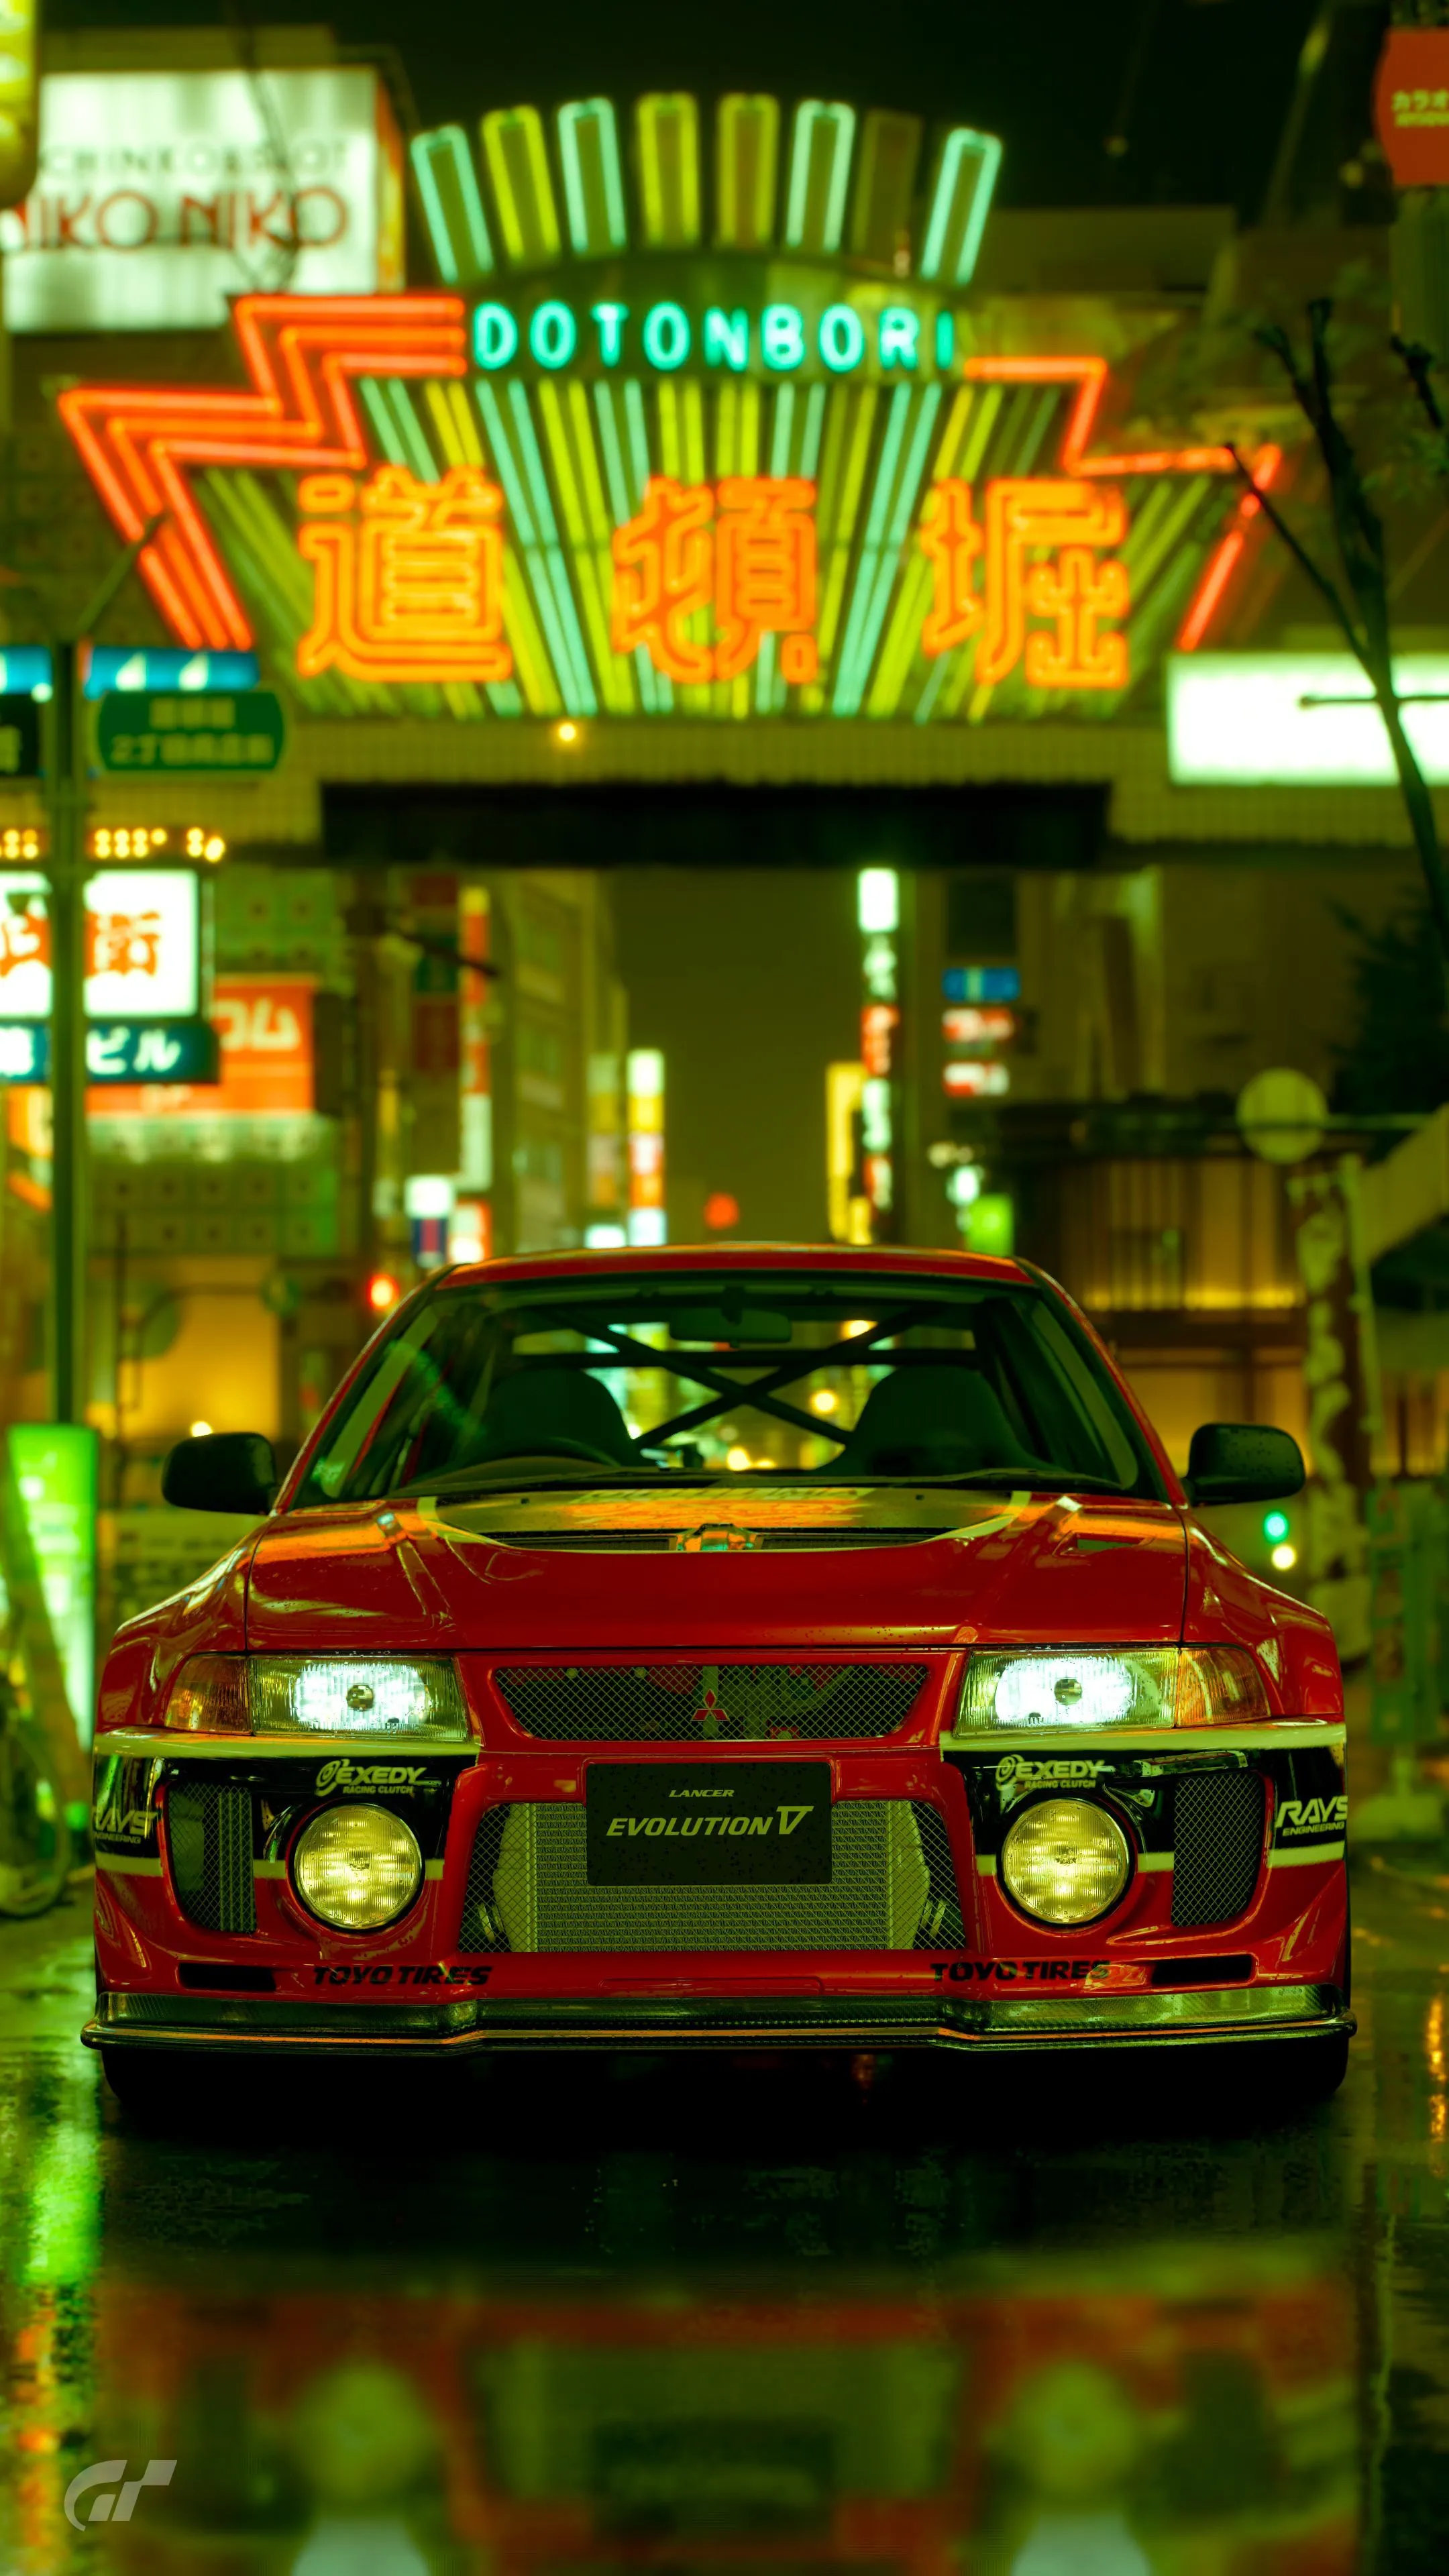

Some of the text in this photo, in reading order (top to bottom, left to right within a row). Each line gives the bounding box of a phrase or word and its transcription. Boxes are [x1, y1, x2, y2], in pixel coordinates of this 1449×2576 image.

[472, 300, 953, 373] DOTONBORI
[297, 464, 1129, 690] 道頓堀
[335, 1766, 427, 1786] EXEDY
[1015, 1760, 1106, 1778] EXEDY
[342, 1785, 413, 1794] RACING CLUTCH
[669, 1789, 735, 1798] LANCER
[1024, 1779, 1096, 1789] RACING CLUTCH
[606, 1817, 773, 1837] EVOLUTION
[1282, 1821, 1345, 1837] ENGINEERING
[313, 1966, 492, 1986] TOYO TIRES
[930, 1960, 1112, 1982] TOYO TIRES
